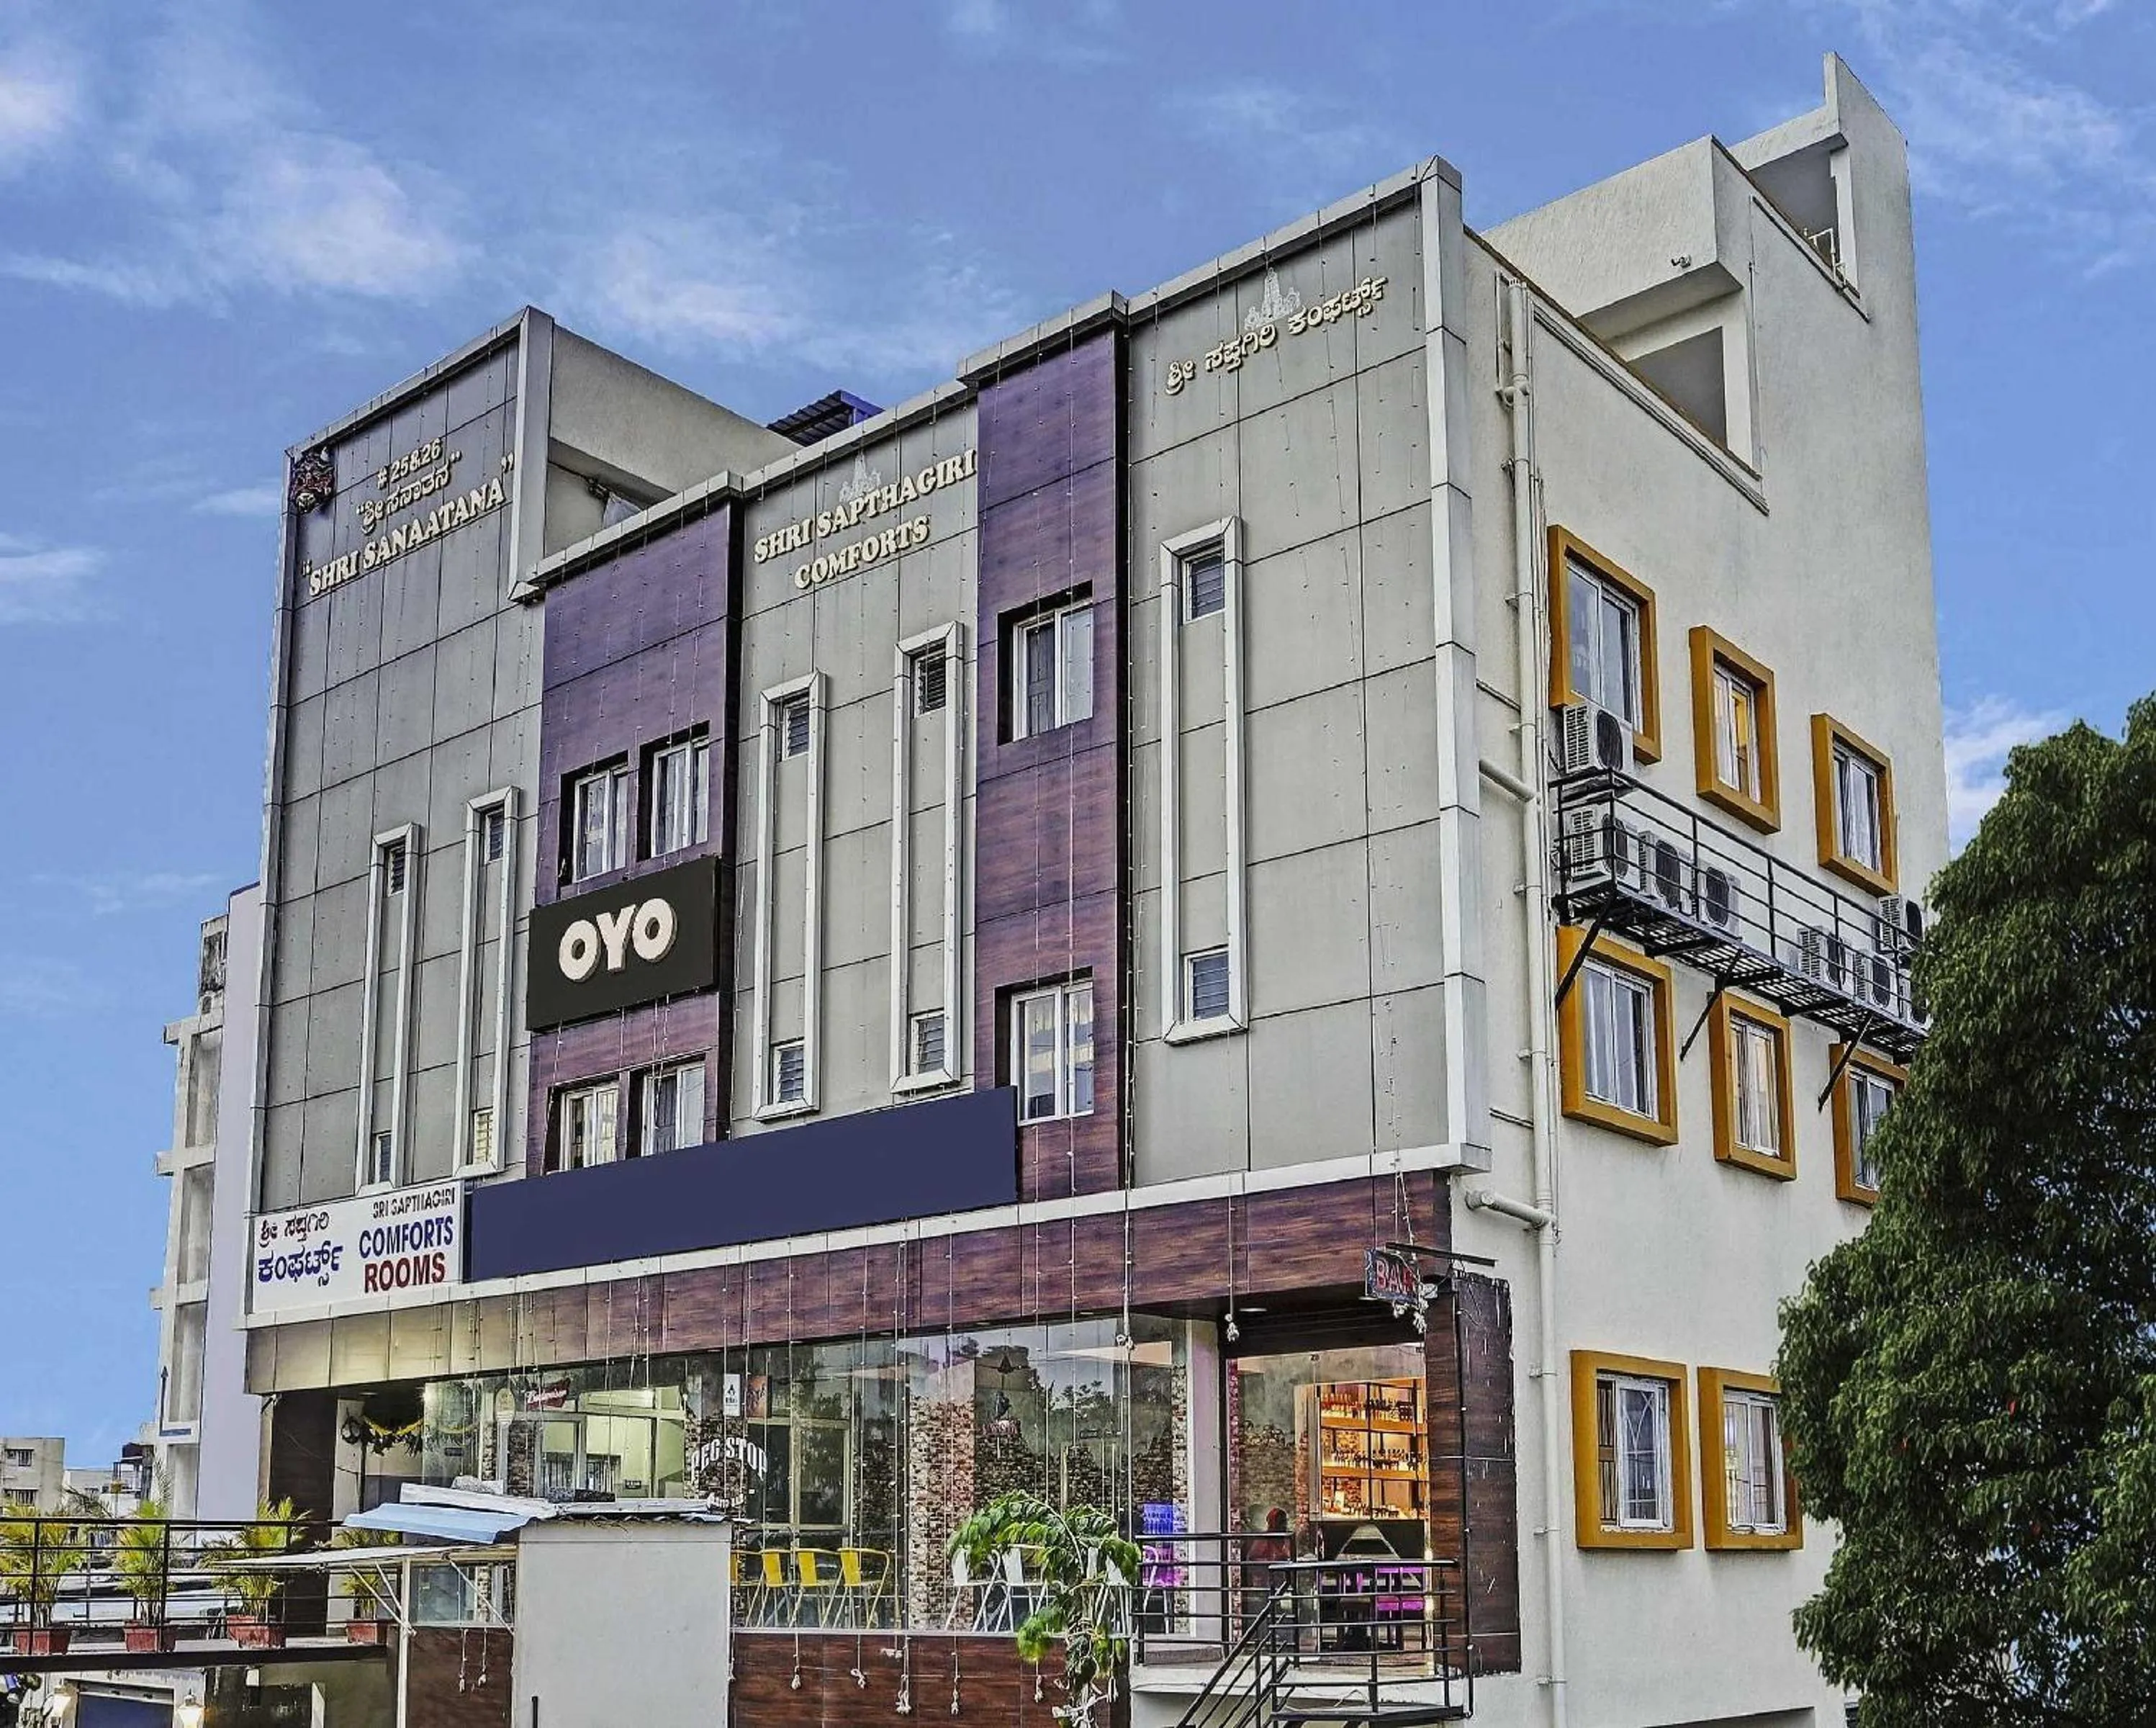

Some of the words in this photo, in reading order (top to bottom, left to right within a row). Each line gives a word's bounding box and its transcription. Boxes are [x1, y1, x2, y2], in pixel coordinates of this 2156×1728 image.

[754, 518, 813, 564] SHRI
[816, 449, 977, 538] SAPTHAGIRI
[794, 515, 929, 590] COMFORTS
[558, 898, 678, 983] OYO
[373, 1200, 389, 1218] SRI
[390, 1187, 456, 1216] SAPTHAGIRI
[359, 1215, 454, 1259] COMFORTS
[364, 1251, 446, 1294] ROOMS
[1376, 1259, 1416, 1295] BAR
[724, 1436, 768, 1482] STOP
